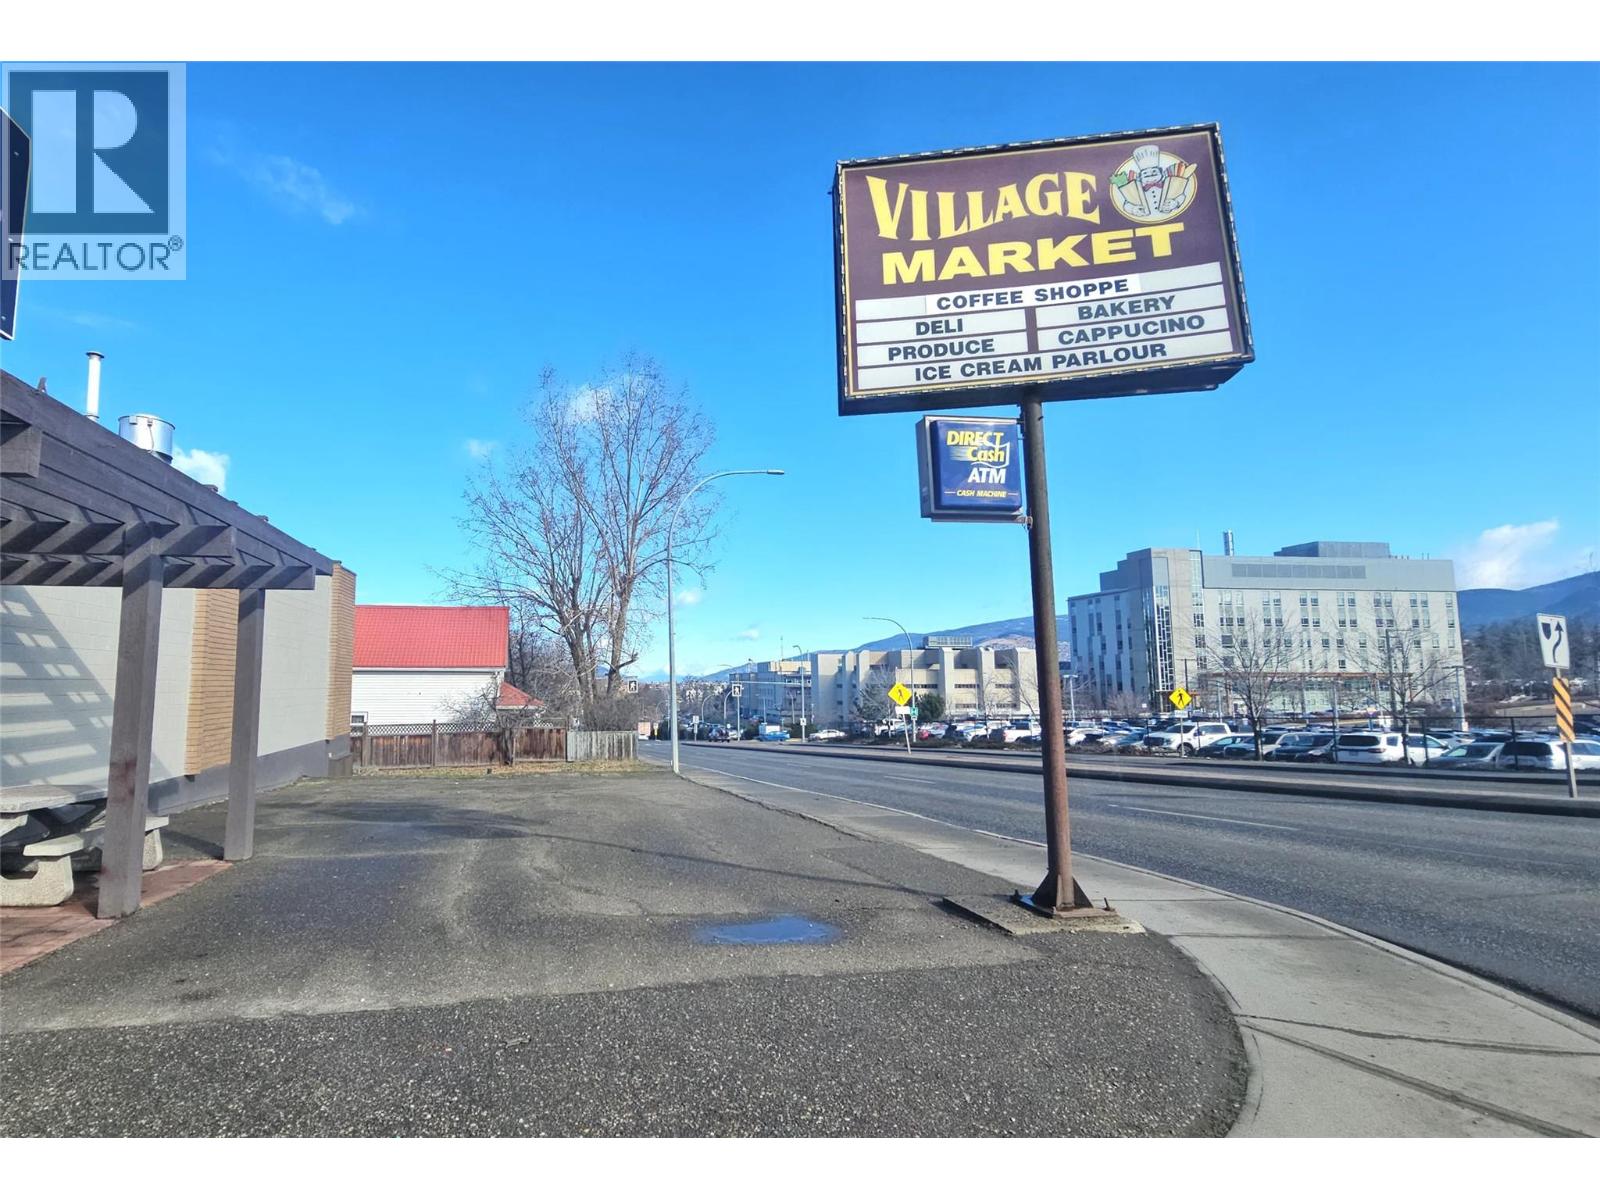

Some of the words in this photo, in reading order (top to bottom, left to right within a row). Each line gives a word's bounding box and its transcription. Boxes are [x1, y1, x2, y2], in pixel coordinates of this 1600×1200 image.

[866, 171, 1100, 241] VILLAGE
[882, 222, 1184, 285] MARKET
[936, 290, 1023, 311] COFFEE
[1034, 279, 1129, 302] SHOPPE
[1078, 295, 1176, 321] BAKERY
[915, 318, 963, 336] DELI
[1058, 315, 1206, 346] CAPPUCINO
[888, 338, 995, 361] PRODUCE
[915, 365, 951, 381] ICE
[960, 356, 1042, 379] CREAM
[1052, 343, 1167, 369] PARLOUR
[946, 430, 1004, 447] DIRECT
[966, 445, 1005, 462] Cash
[967, 467, 1007, 484] ATM
[956, 489, 975, 497] CASH
[976, 489, 1007, 498] MACHINE
